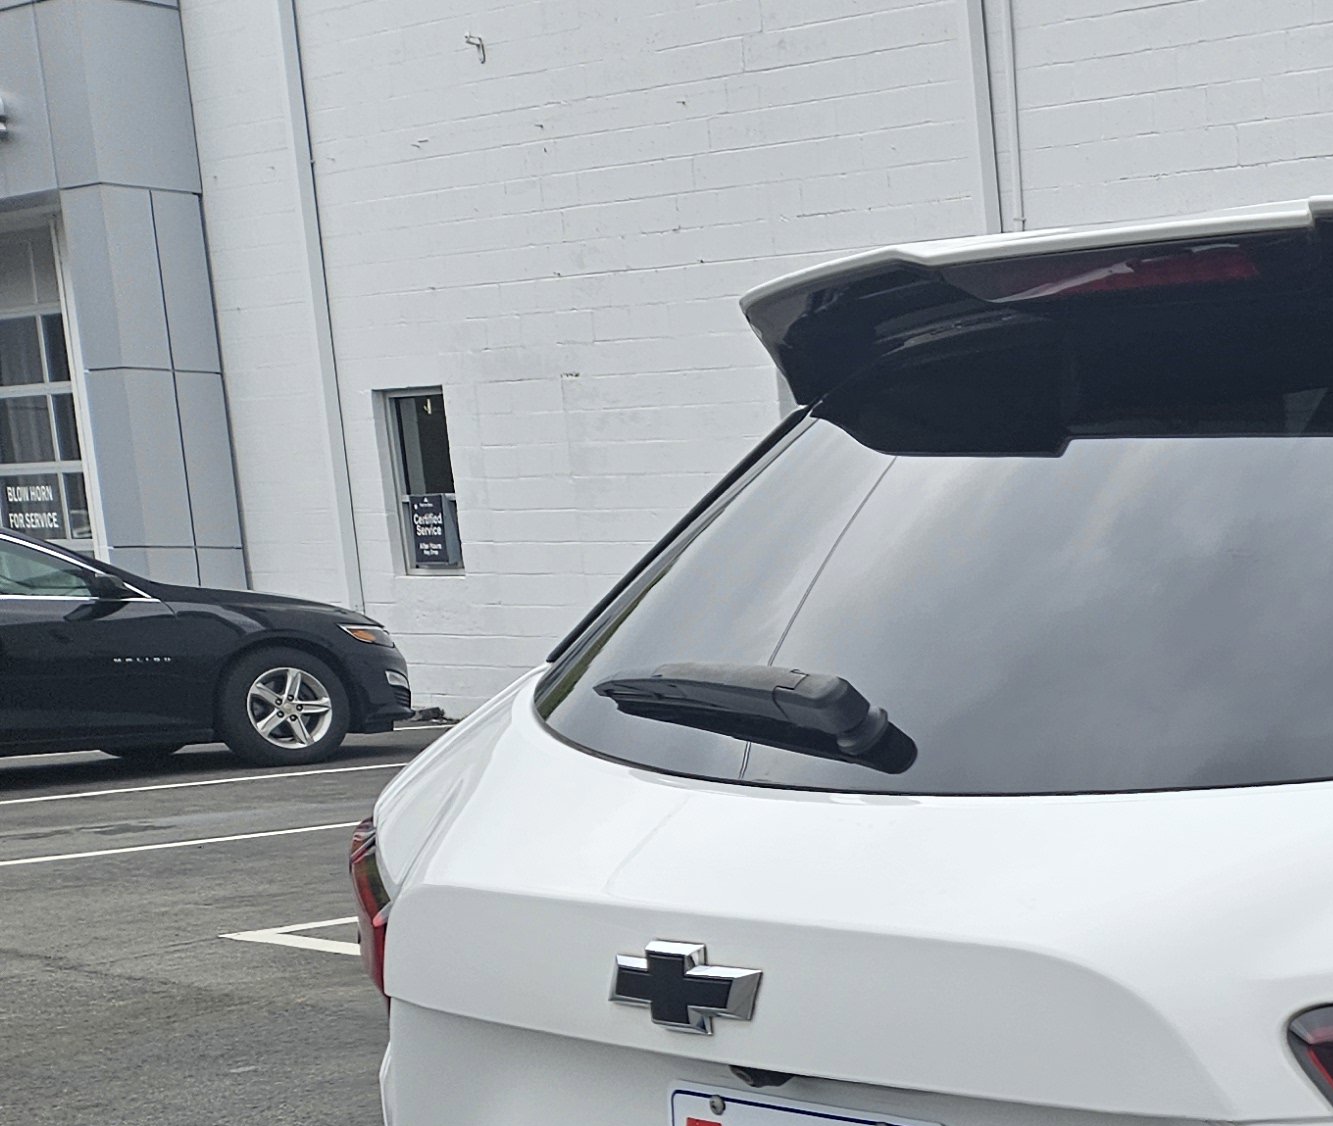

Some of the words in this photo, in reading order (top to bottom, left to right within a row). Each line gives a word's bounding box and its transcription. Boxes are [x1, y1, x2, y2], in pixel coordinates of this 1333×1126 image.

[6, 485, 30, 502] BLOW
[29, 485, 54, 502] HORN
[8, 512, 25, 529] FOR
[25, 511, 60, 529] SERVICE
[413, 512, 443, 525] Certified
[416, 524, 442, 536] Service
